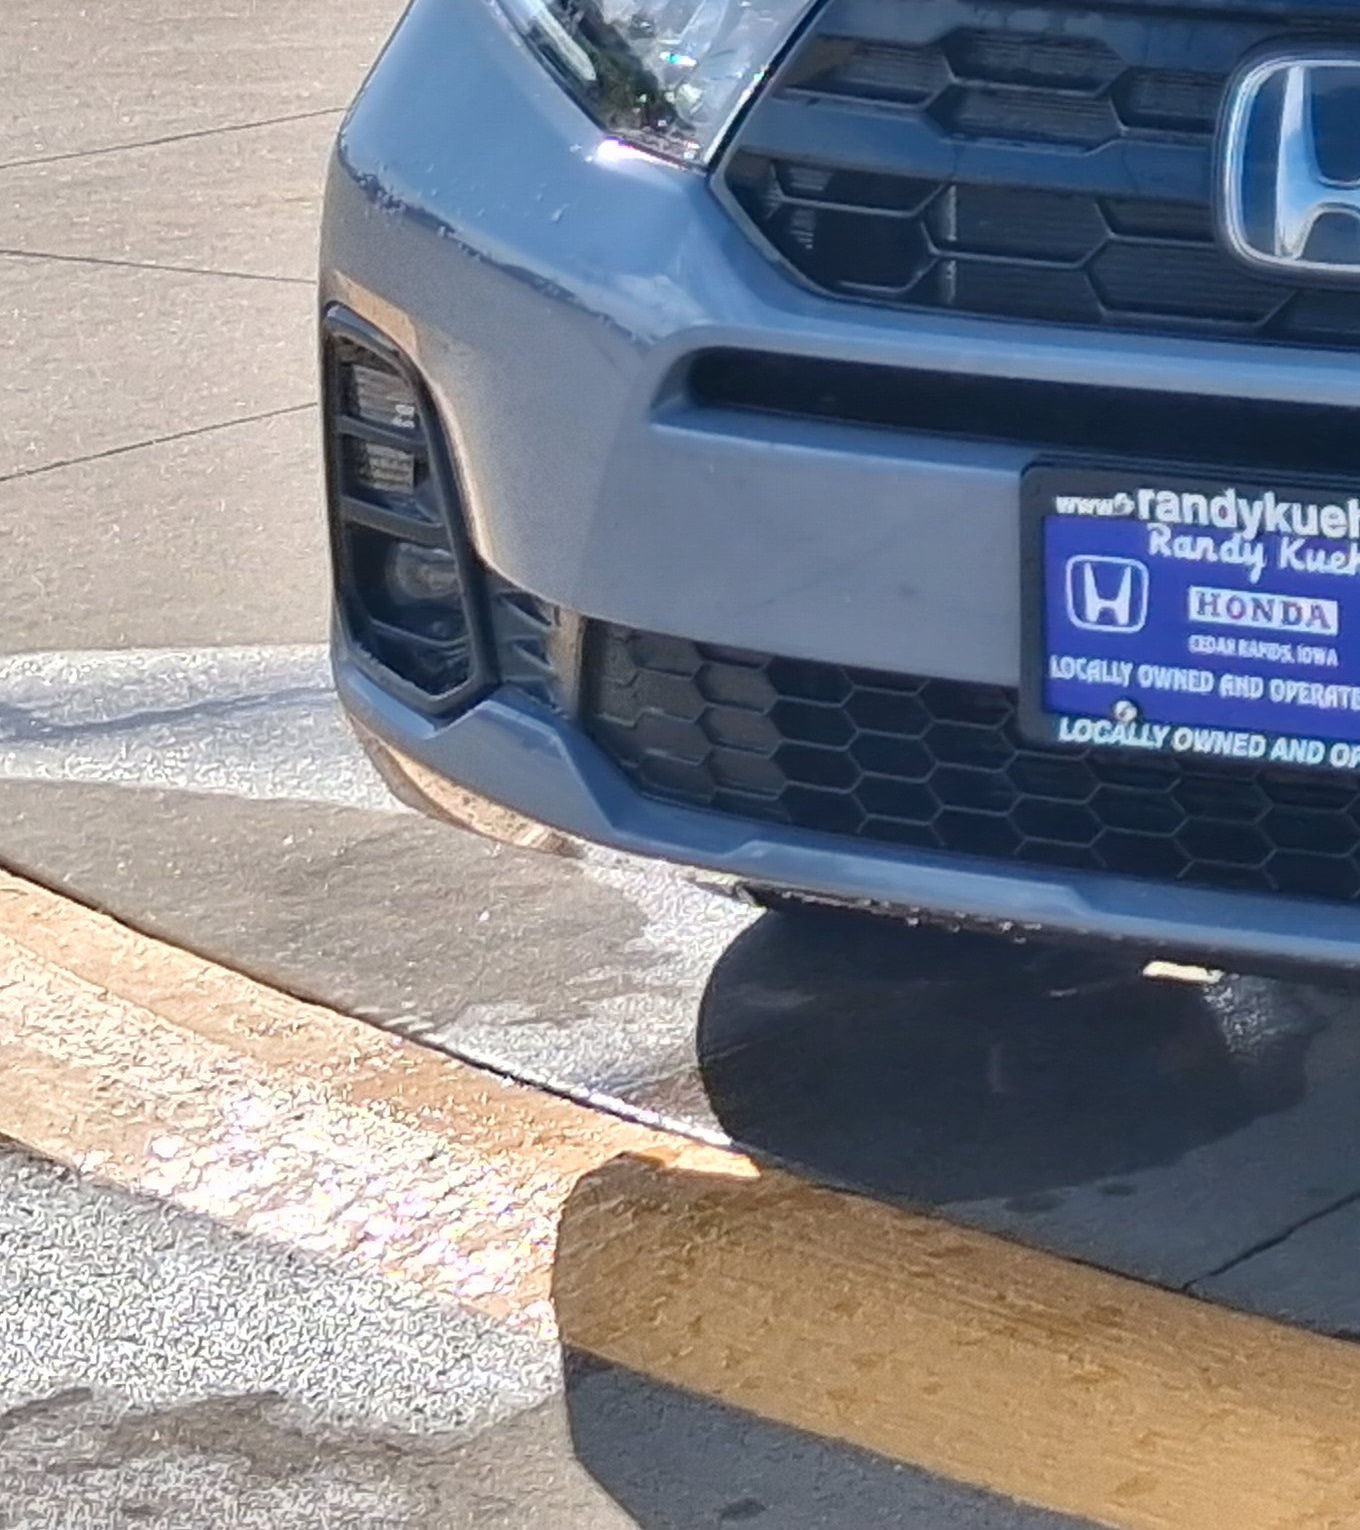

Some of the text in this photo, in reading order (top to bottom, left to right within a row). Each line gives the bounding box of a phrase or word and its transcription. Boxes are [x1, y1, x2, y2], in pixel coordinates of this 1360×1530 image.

[1147, 522, 1266, 583] Randy
[1195, 590, 1332, 630] HONDA
[1050, 654, 1133, 687] LOCALLY
[1138, 664, 1215, 693] OWNED
[1219, 673, 1264, 699] AND
[1297, 643, 1339, 667] IOWA
[1058, 717, 1171, 750] LOCALLY
[1172, 727, 1266, 758] OWNED
[1270, 737, 1326, 765] AND
